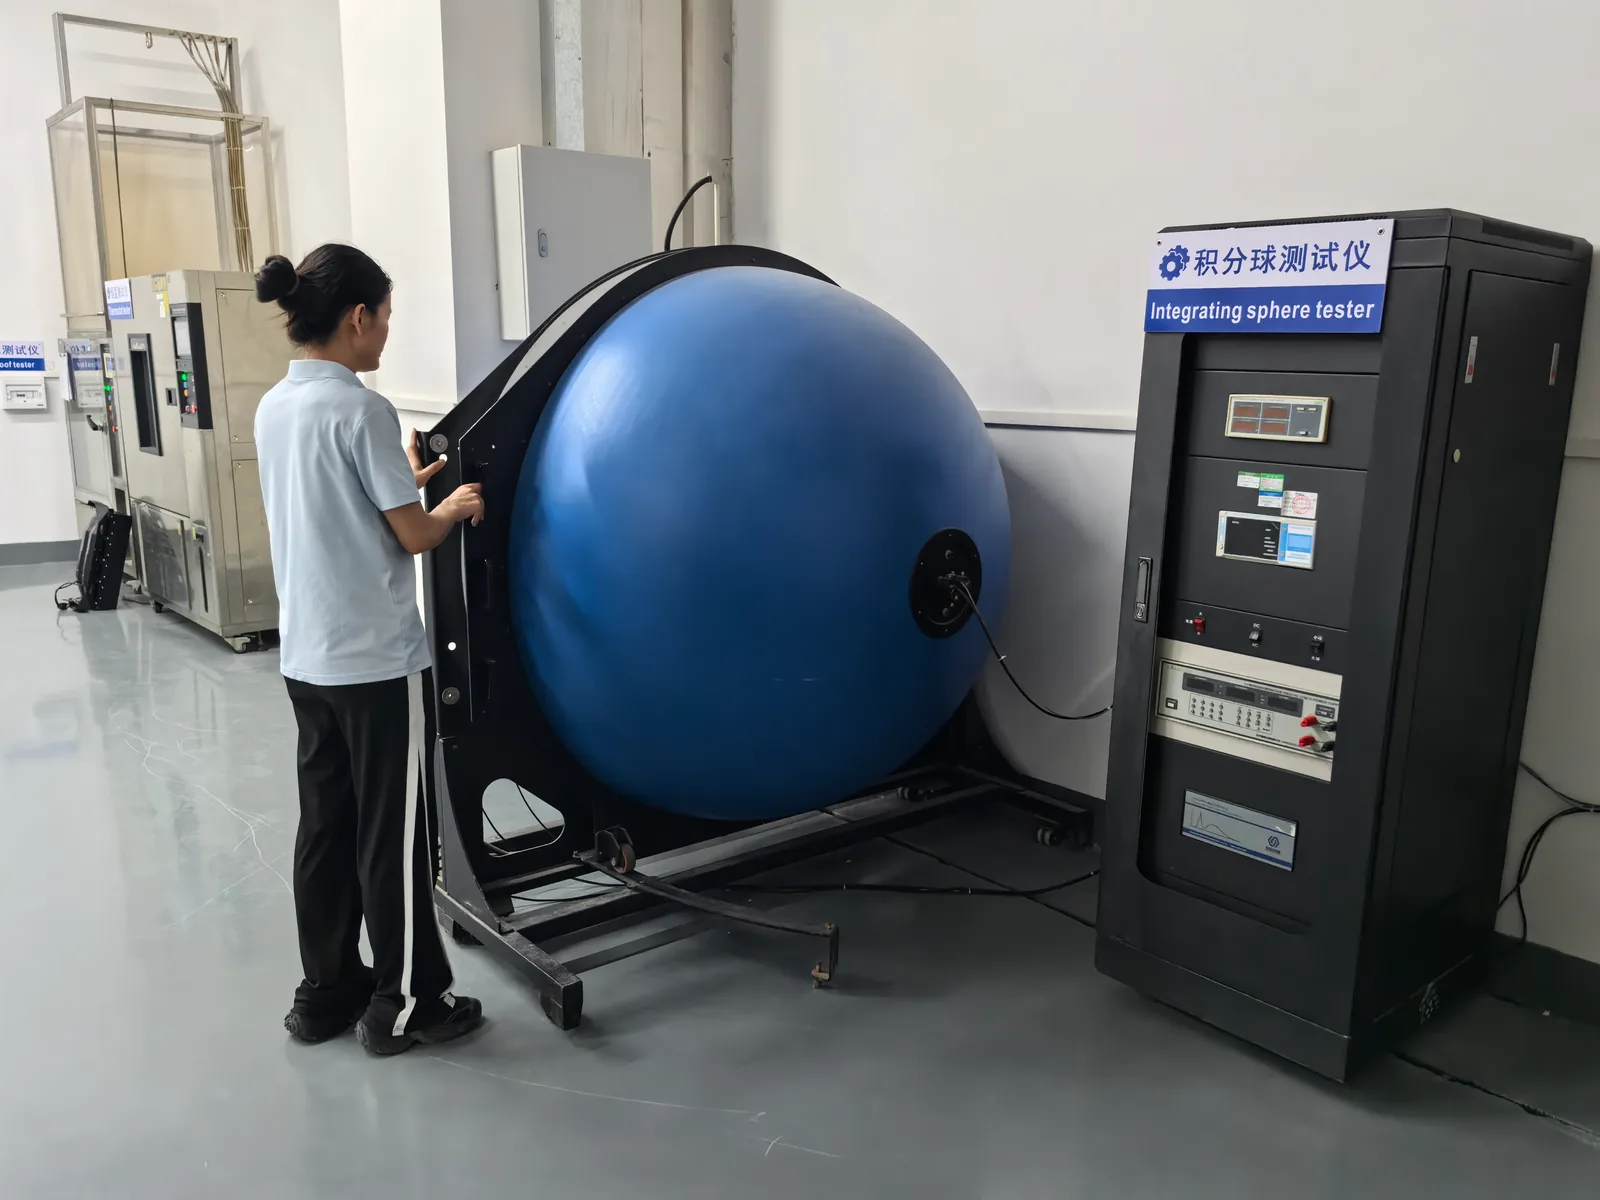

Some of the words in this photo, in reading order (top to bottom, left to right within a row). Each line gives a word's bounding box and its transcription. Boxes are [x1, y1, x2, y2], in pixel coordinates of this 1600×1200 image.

[1194, 240, 1371, 277] 积分球测试仪
[1150, 301, 1242, 323] Integrating
[1246, 300, 1311, 323] sphere
[1315, 299, 1375, 319] tester
[0, 344, 40, 356] 测试仪
[13, 361, 35, 369] tester
